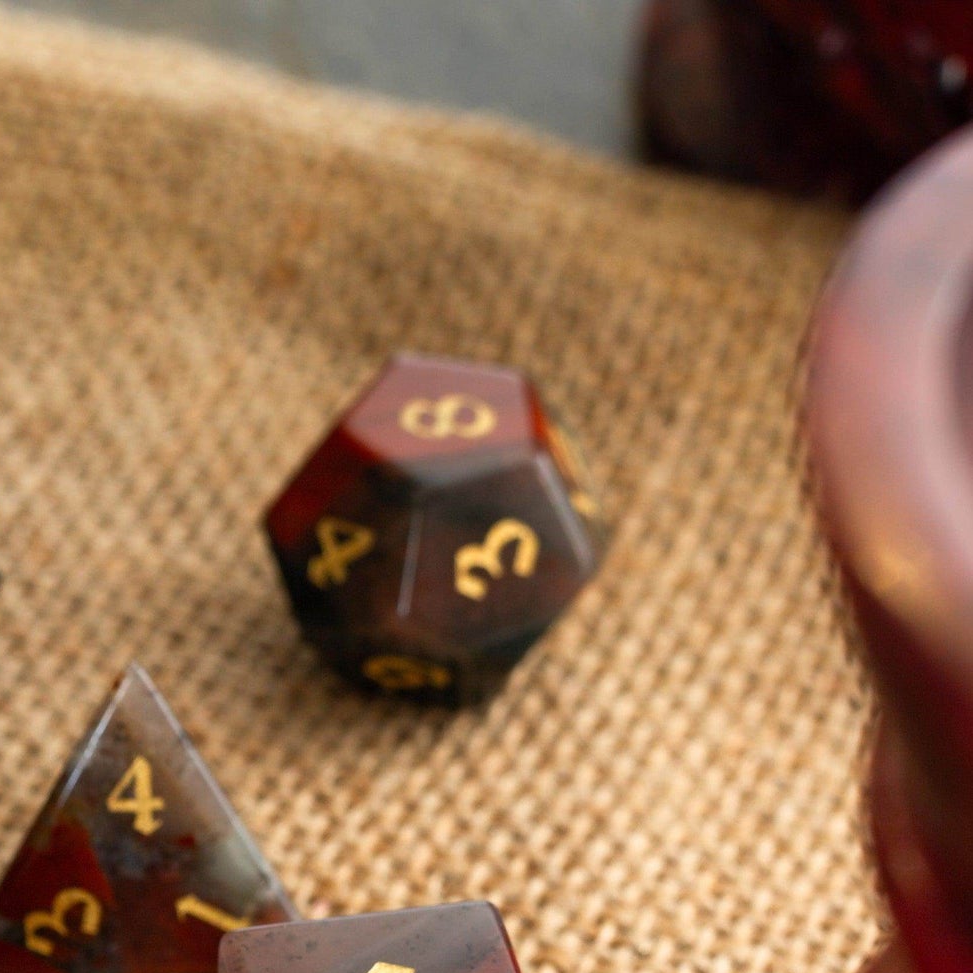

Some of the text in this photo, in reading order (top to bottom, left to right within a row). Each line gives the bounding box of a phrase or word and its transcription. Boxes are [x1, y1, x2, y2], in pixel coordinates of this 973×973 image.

[398, 394, 497, 438] 8
[307, 516, 375, 589] 4
[454, 517, 540, 600] 3
[106, 755, 165, 836] 4
[23, 887, 103, 957] 3
